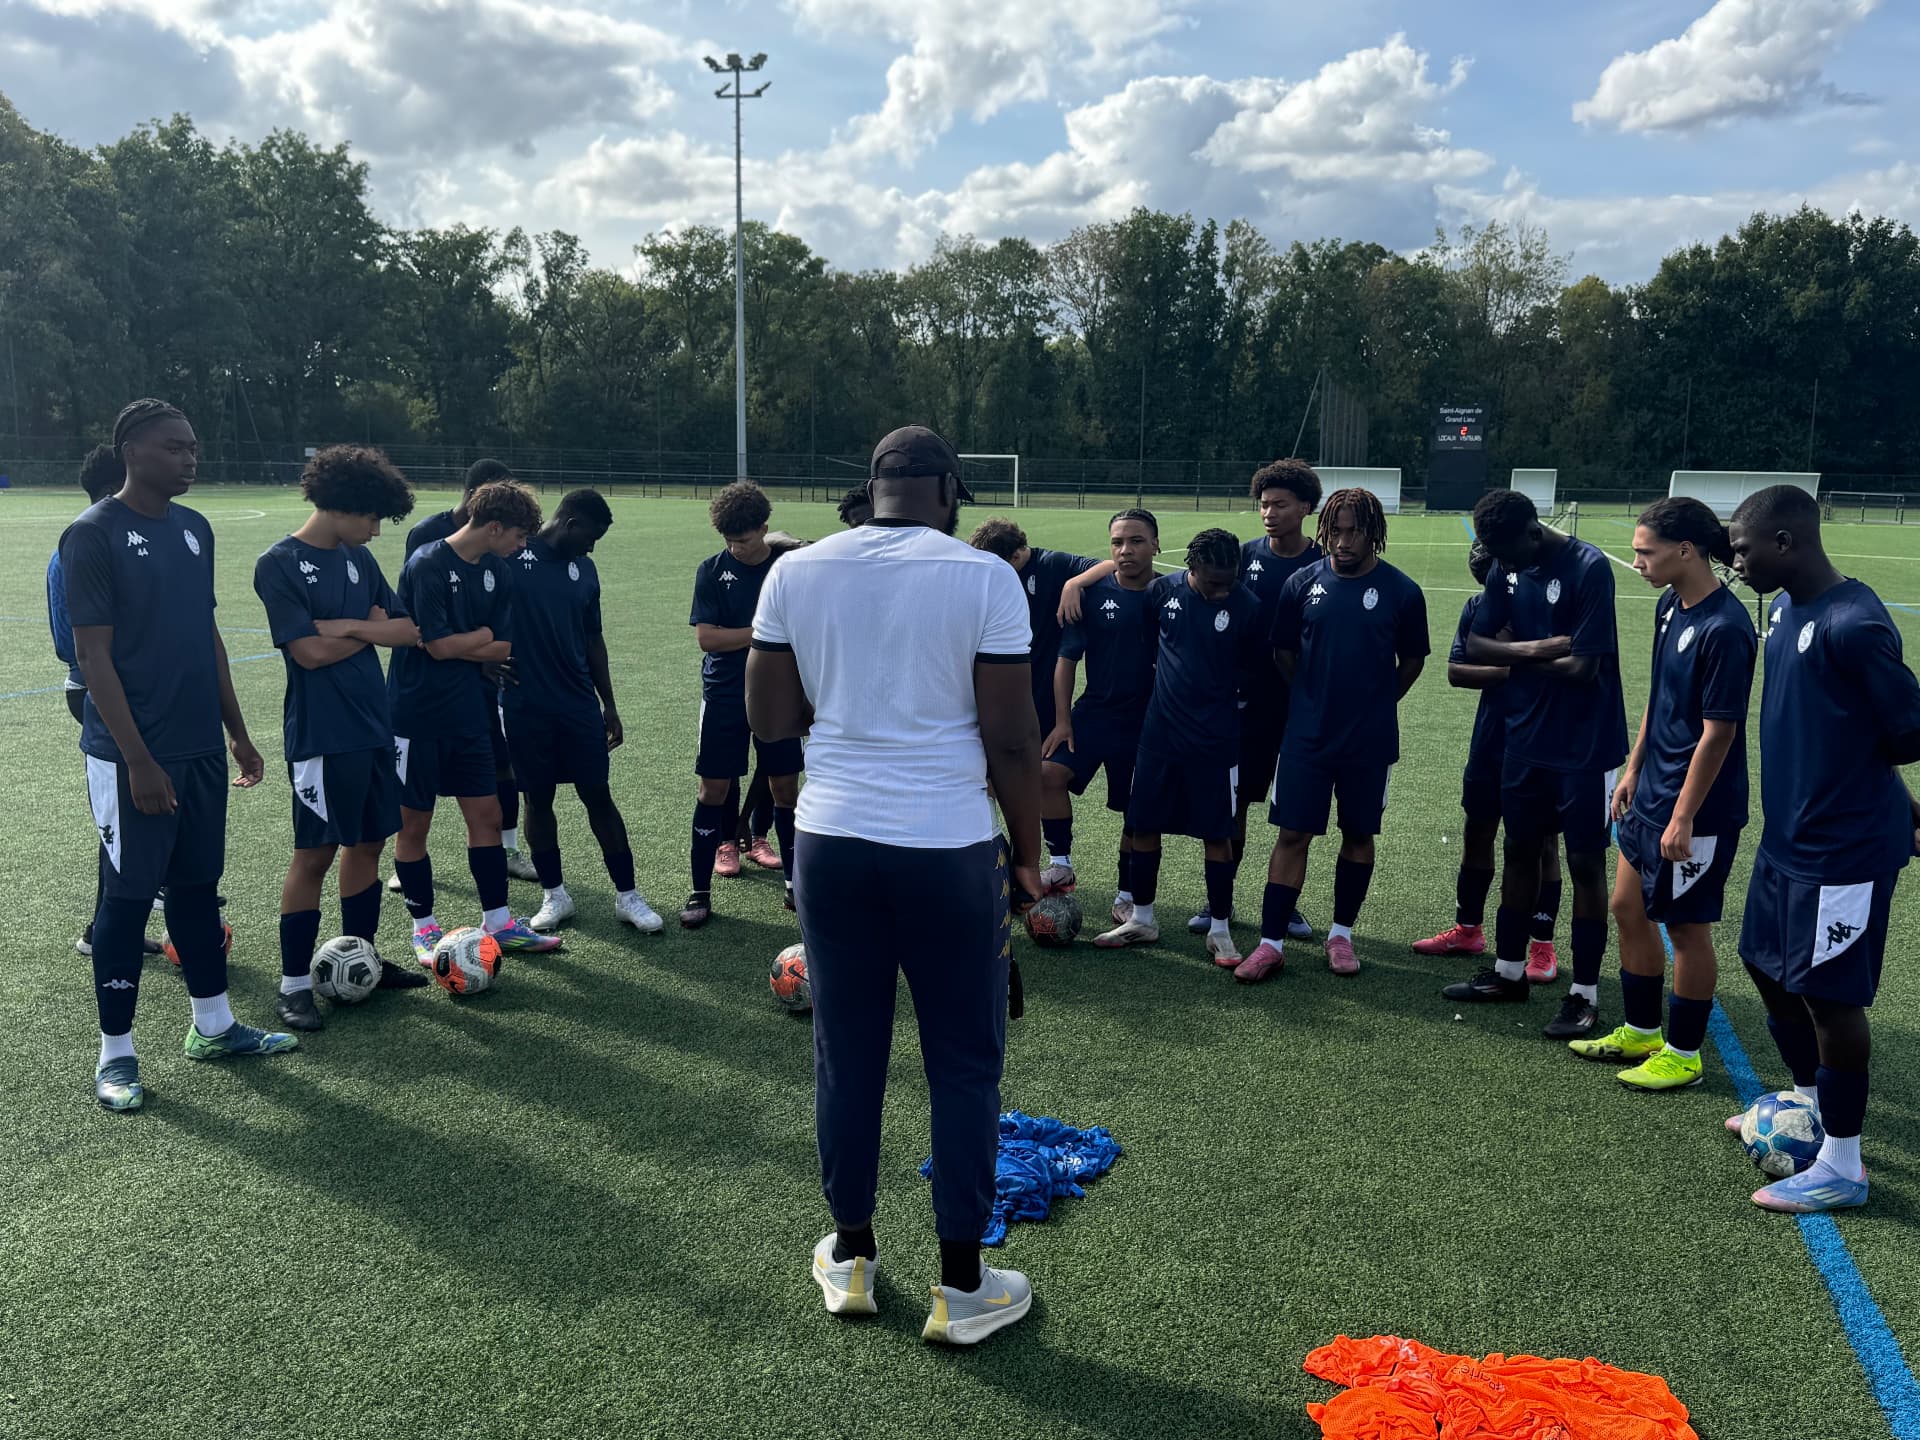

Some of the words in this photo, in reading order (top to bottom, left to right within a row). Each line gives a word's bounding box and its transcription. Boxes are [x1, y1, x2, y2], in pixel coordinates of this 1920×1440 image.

[137, 547, 149, 557] 44
[305, 575, 318, 584] 36
[1311, 597, 1321, 605] 37
[1106, 612, 1115, 620] 15
